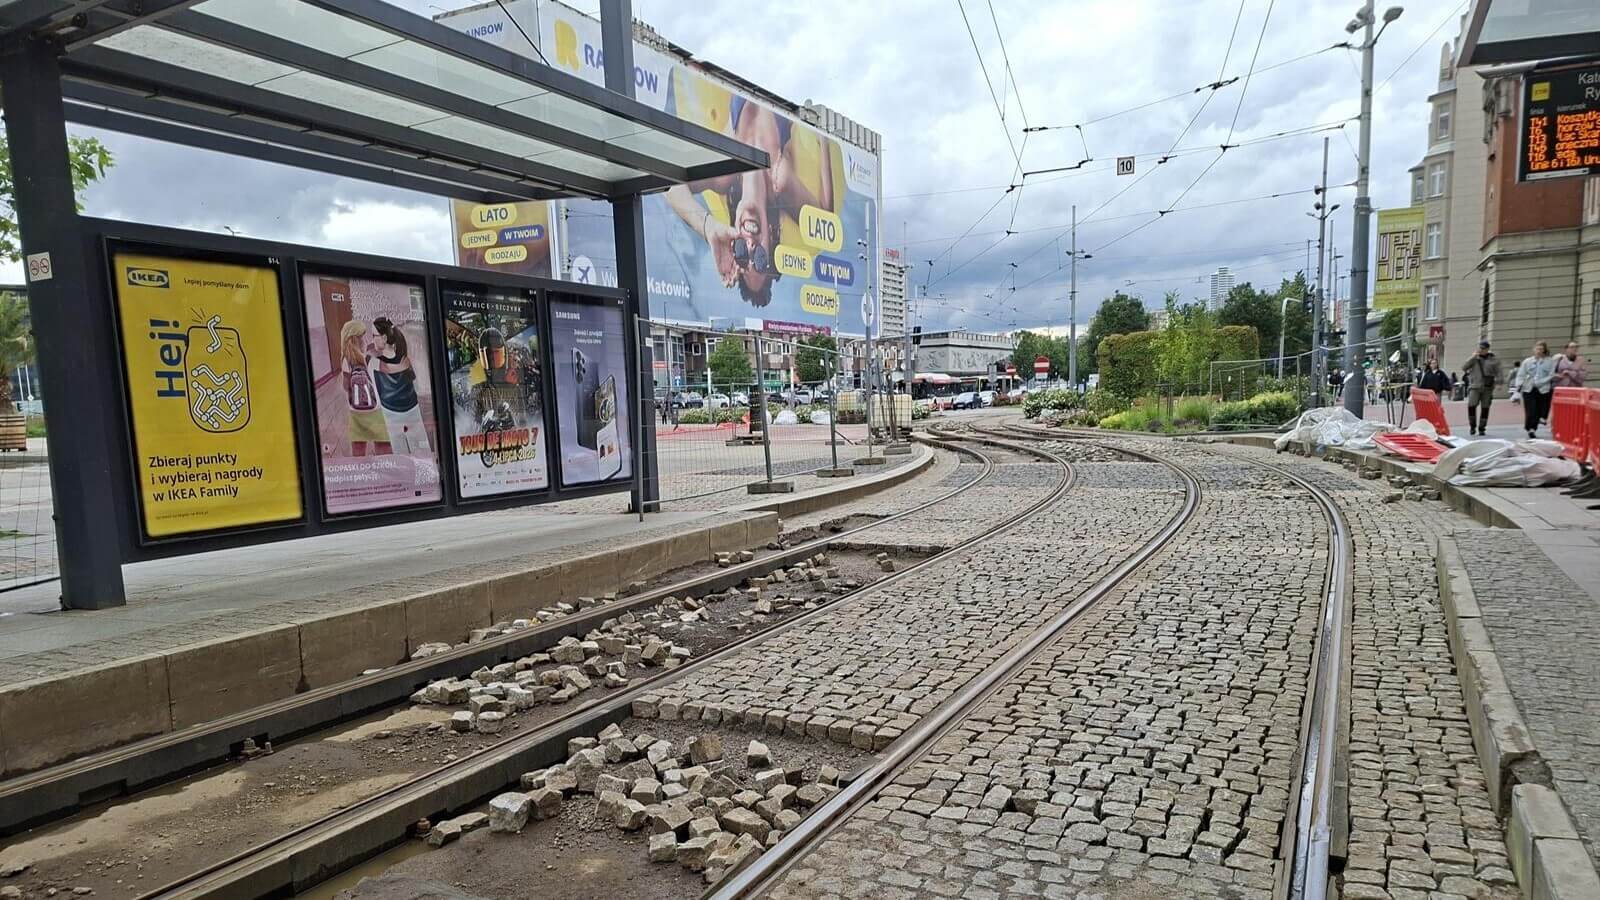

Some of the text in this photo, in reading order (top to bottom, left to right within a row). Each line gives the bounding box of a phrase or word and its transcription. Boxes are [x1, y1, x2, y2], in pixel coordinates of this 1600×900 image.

[1120, 160, 1132, 171] 10
[480, 207, 508, 223] LATO
[505, 228, 539, 240] W TWOIM
[808, 216, 835, 242] LATO
[468, 234, 491, 246] JEDYNE
[491, 249, 521, 260] RODZAJU
[782, 253, 806, 271] JEDYNE
[132, 270, 165, 283] IKEA
[820, 262, 850, 280] W TWOIM
[453, 300, 490, 310] KATOWICE
[555, 311, 581, 320] SAMSUNG
[150, 319, 189, 397] Hej!
[459, 427, 539, 455] TOUR DE MOTO 7
[149, 453, 237, 469] Zbieraj punkty
[151, 466, 263, 486] i wybieraj nagrody
[153, 484, 239, 502] w IKEA Family
